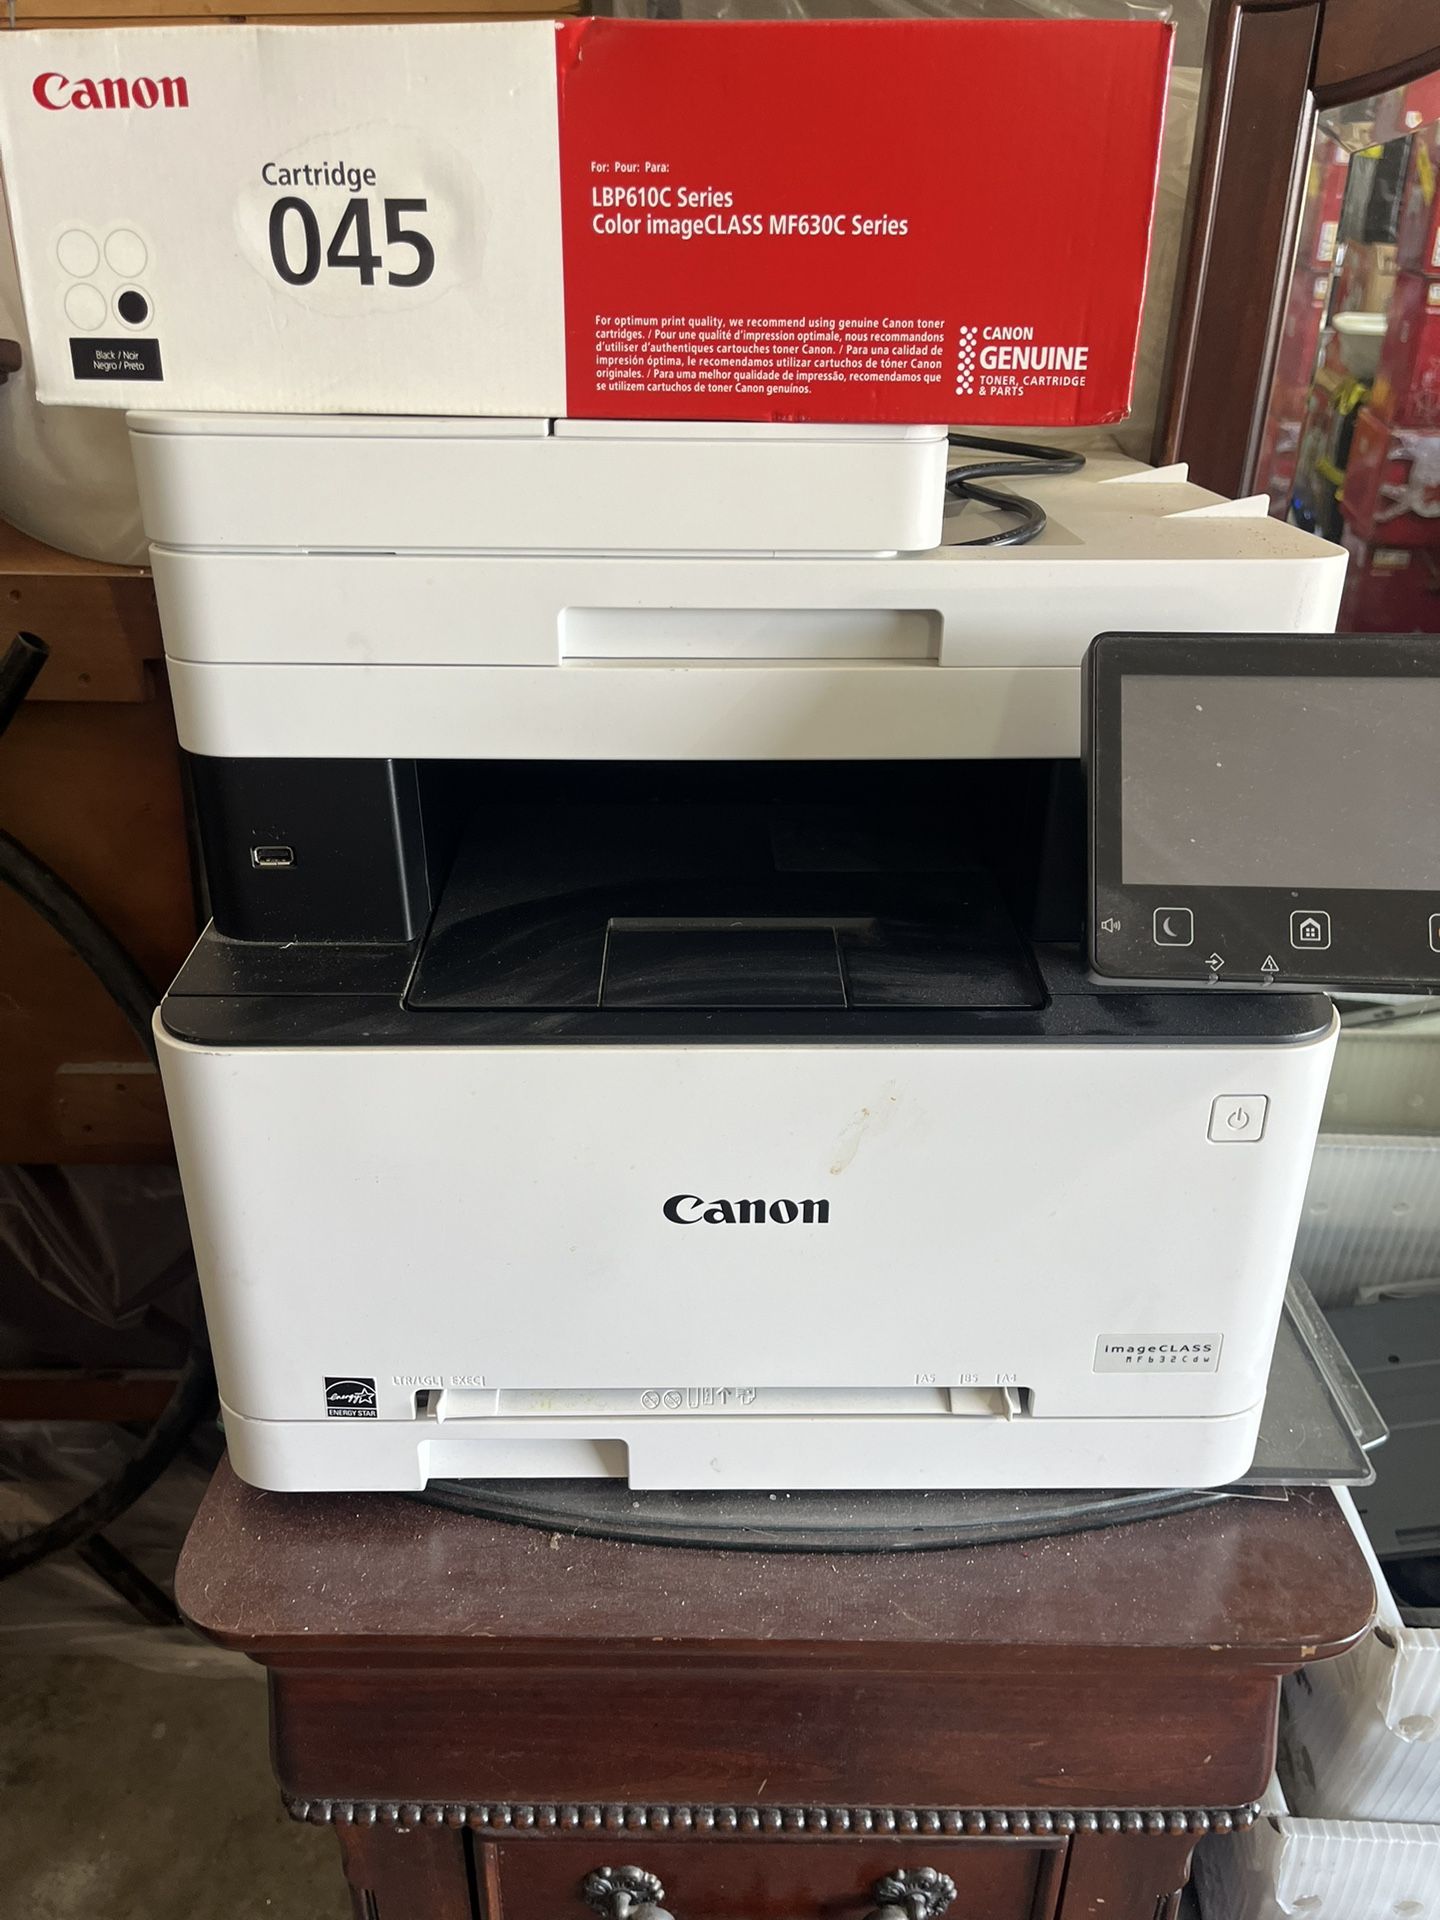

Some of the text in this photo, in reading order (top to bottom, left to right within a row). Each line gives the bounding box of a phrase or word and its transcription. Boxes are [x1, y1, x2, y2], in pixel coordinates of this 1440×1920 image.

[33, 73, 188, 110] Canon
[590, 161, 670, 173] For: Pour: Para:
[262, 161, 376, 192] Cartridge
[593, 187, 732, 207] LBP610C Series
[593, 213, 907, 239] Color imageCLASS MF630C Series
[269, 197, 434, 287] 045
[595, 314, 945, 331] For optimum print quality, we recommend using genuine Canon toner
[595, 328, 645, 342] cartridges.
[654, 328, 677, 340] Pour
[678, 331, 697, 340] une
[698, 329, 732, 342] qualité
[796, 330, 842, 343] optimale,
[844, 333, 869, 342] nous
[870, 331, 945, 343] recommandons
[982, 327, 1034, 341] CANON
[95, 350, 116, 360] Black
[122, 351, 139, 361] Noir
[716, 343, 770, 354] cartouches
[772, 345, 800, 354] toner
[801, 343, 836, 355] Canon.
[846, 344, 869, 355] Para
[870, 346, 890, 355] una
[891, 344, 929, 356] calidad
[930, 344, 944, 356] de
[596, 354, 943, 369] impresión óptima, le recomendamos utilizar cartuchos de tóner Canon
[980, 346, 1088, 370] GENUINE
[93, 360, 118, 372] Negro
[123, 360, 145, 371] Preto
[595, 367, 645, 381] originales.
[653, 368, 675, 379] Para
[676, 370, 697, 379] uma
[698, 368, 732, 380] melhor
[733, 369, 780, 382] qualidade
[781, 369, 794, 381] de
[795, 370, 847, 383] impressão,
[849, 371, 922, 382] recomendamos
[923, 374, 942, 385] que
[979, 375, 1086, 388] TONER, CARTRIDGE
[596, 380, 812, 396] se utilizem cartuchos de toner Canon genuínos.
[990, 386, 1024, 397] PARTS
[663, 1195, 829, 1224] Canon
[1104, 1344, 1212, 1355] imageCLASS
[919, 1373, 937, 1384] A5
[358, 1409, 376, 1417] STAR
